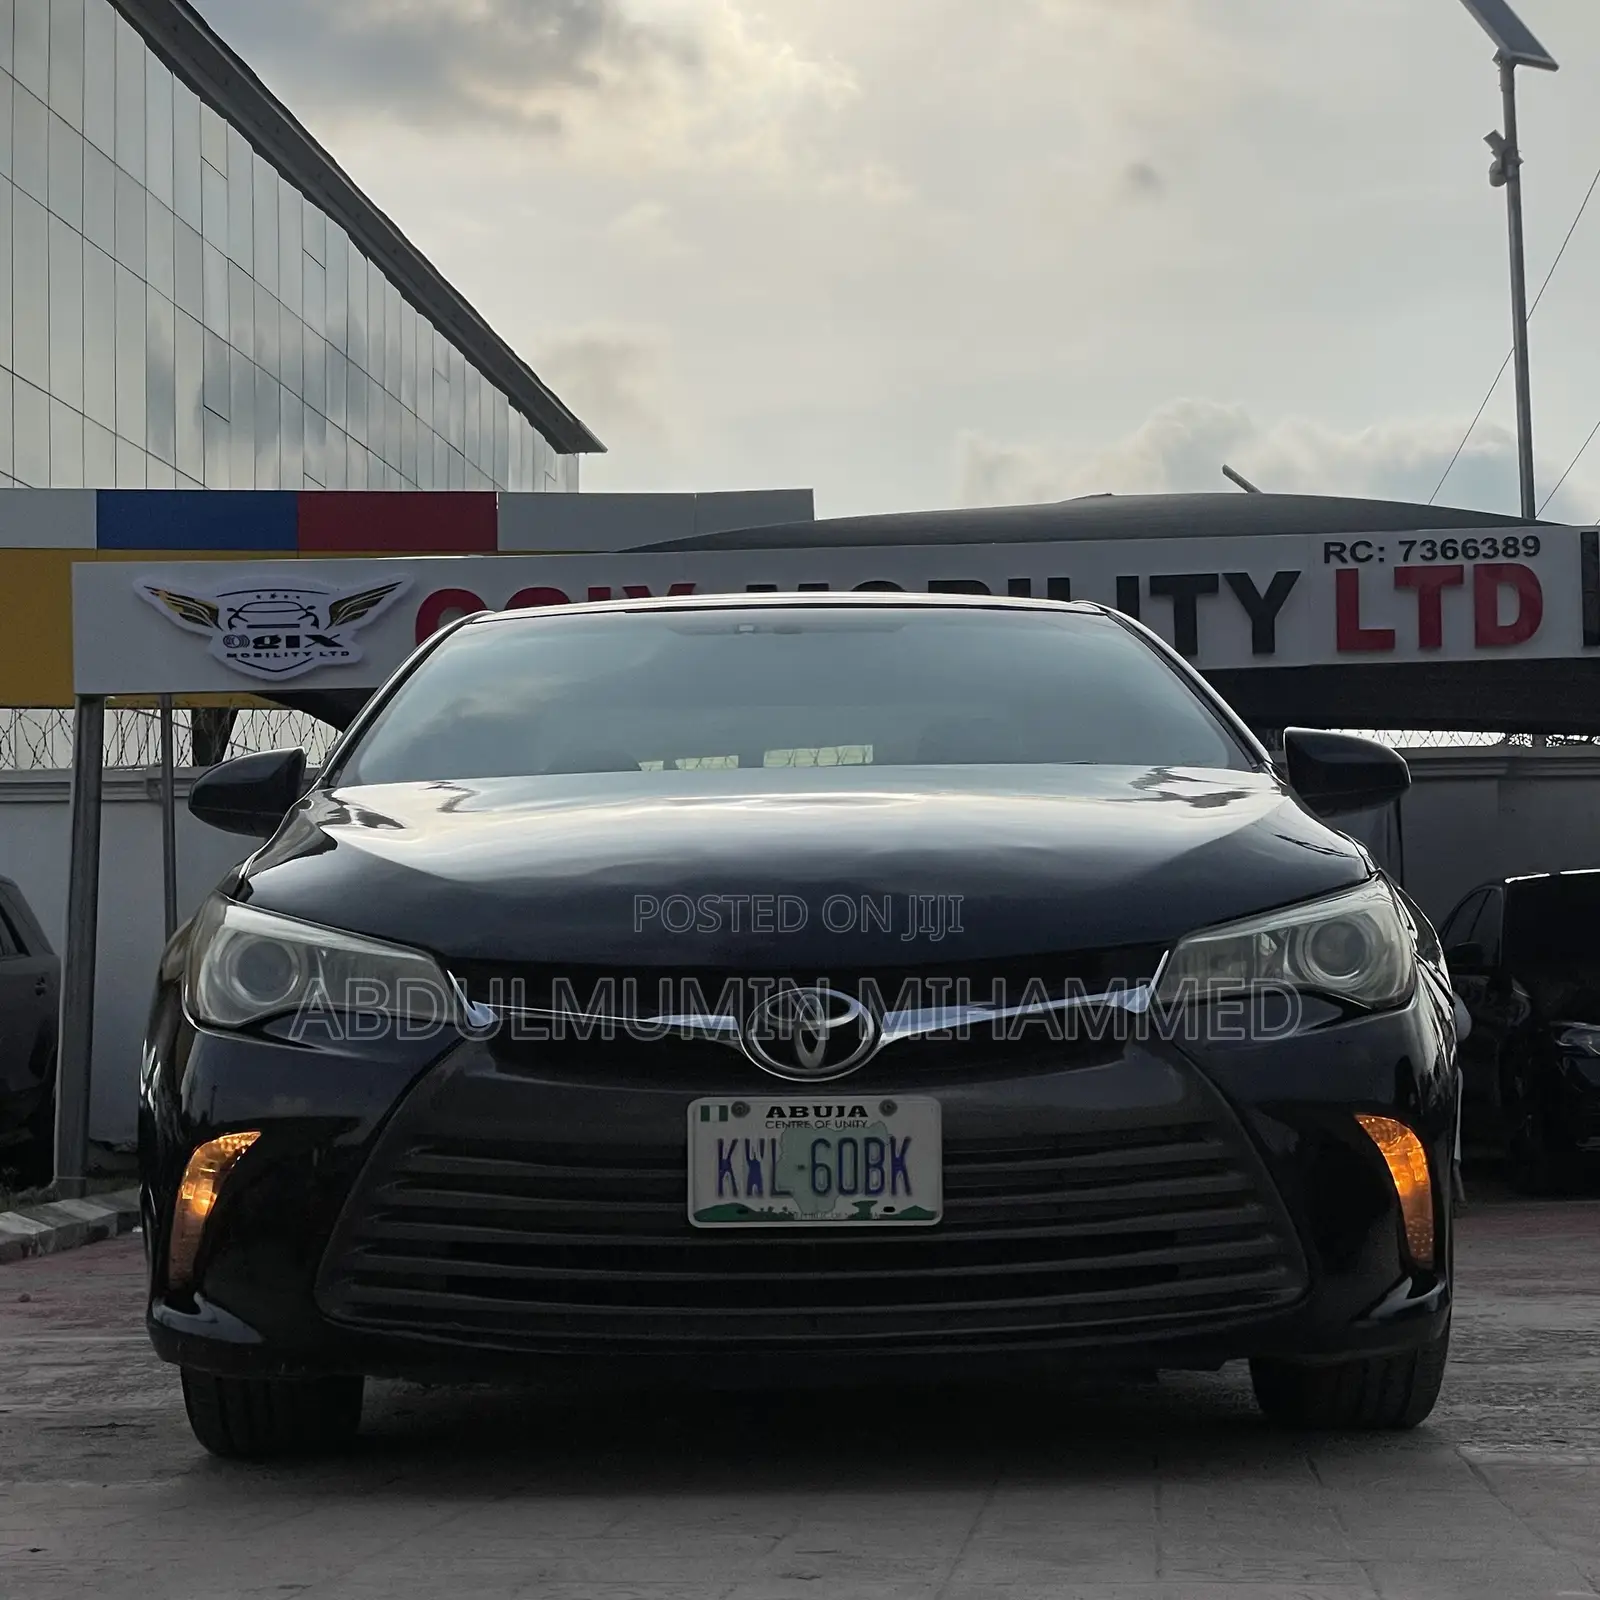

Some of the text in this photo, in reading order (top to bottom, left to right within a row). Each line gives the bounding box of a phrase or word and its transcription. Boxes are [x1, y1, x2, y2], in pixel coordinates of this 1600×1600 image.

[1323, 535, 1541, 564] RC: 7366389
[1335, 562, 1544, 652] LTD
[226, 651, 312, 659] MOBILITY
[765, 1105, 869, 1118] ABUJA
[765, 1119, 869, 1129] CENTRE OF UNITY
